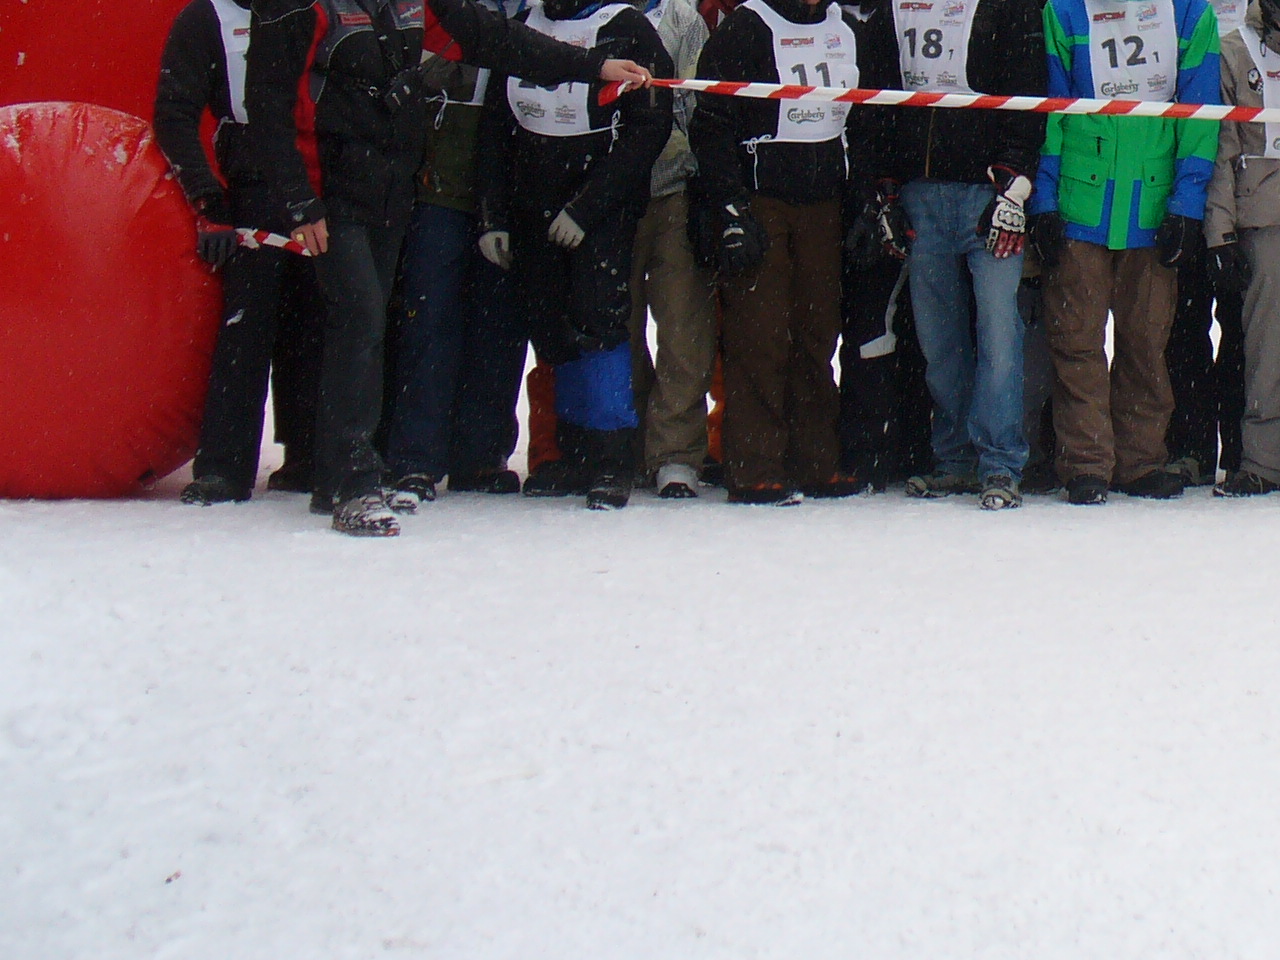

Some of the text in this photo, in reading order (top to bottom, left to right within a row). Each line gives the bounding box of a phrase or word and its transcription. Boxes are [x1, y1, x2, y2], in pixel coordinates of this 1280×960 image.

[904, 28, 943, 59] 18
[1101, 35, 1160, 68] 12 1
[791, 62, 831, 88] 11
[1101, 79, 1139, 97] Carlsberg
[787, 106, 825, 124] Carlsberg
